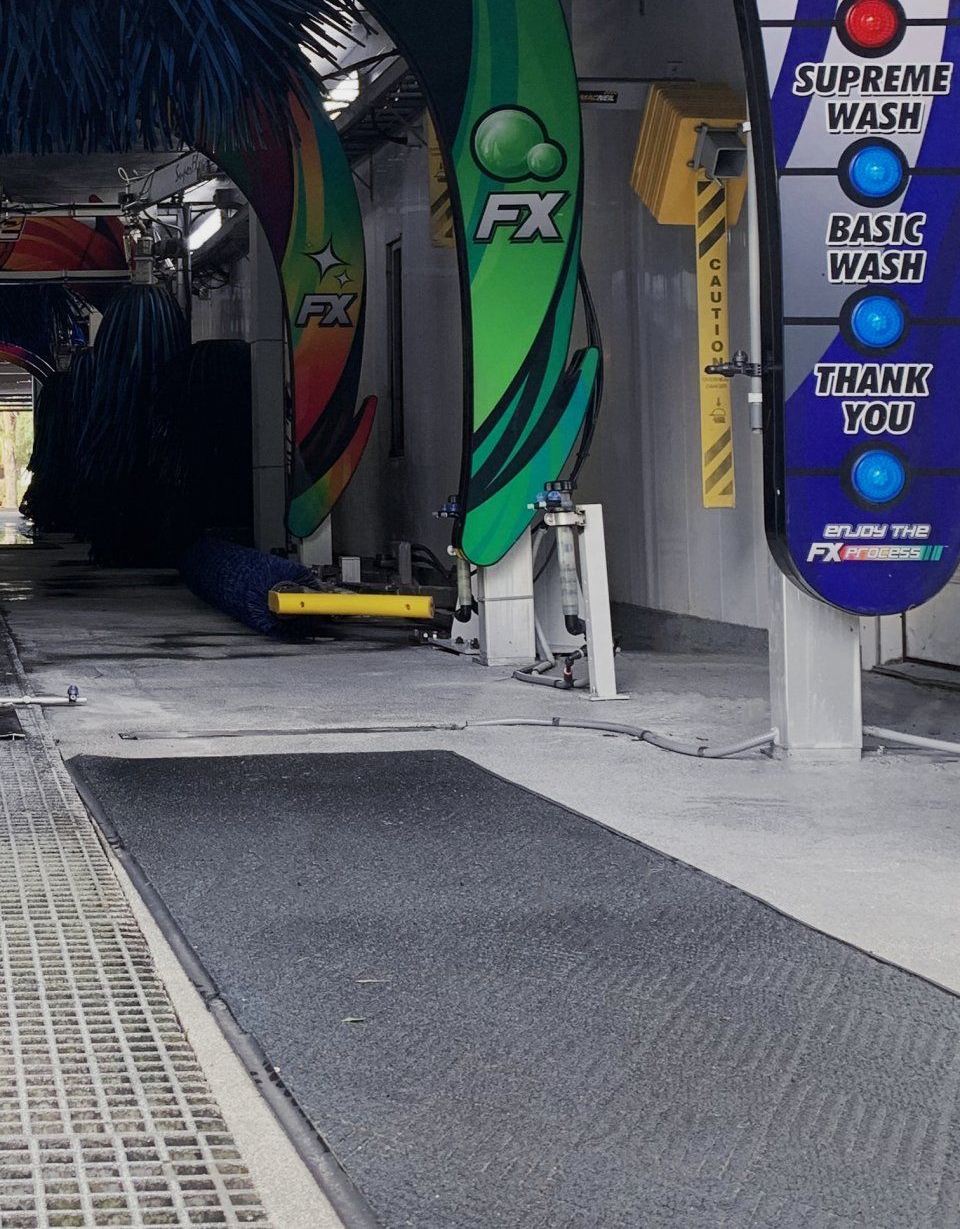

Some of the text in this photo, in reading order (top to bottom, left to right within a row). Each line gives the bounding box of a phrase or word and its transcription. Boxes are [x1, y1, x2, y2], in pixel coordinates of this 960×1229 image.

[795, 64, 951, 95] SUPREME
[827, 102, 922, 131] WASH
[473, 191, 571, 244] FX
[829, 214, 926, 244] BASIC
[828, 252, 926, 283] WASH
[295, 293, 358, 328] FX
[709, 258, 724, 365] CAUTION
[815, 365, 932, 396] THANK
[844, 403, 914, 433] YOU
[806, 542, 844, 562] FX
